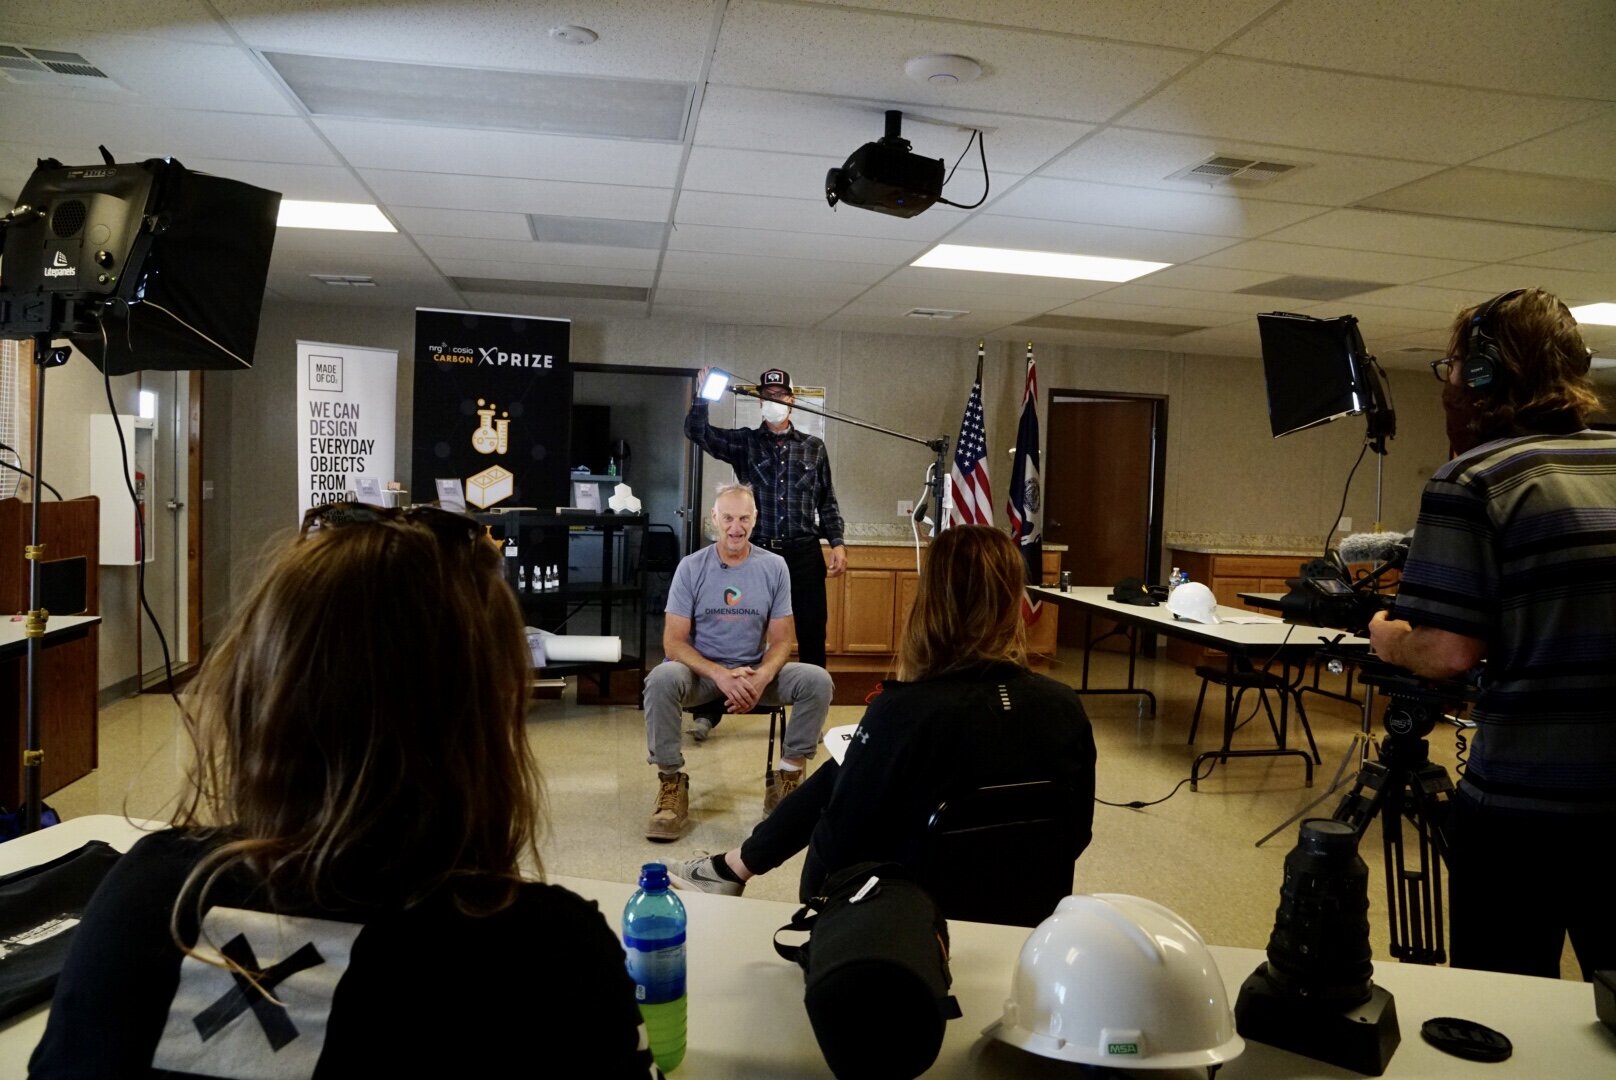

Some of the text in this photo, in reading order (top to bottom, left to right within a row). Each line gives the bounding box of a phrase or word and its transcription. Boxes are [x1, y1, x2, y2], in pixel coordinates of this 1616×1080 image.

[44, 267, 76, 277] Litepanels
[429, 345, 442, 353] nrg
[433, 346, 553, 368] CARBON XPRIZE
[316, 363, 336, 374] MADE
[316, 373, 325, 382] OF
[309, 401, 360, 419] WE CAN
[309, 420, 357, 437] DESIGN
[310, 438, 375, 455] EVERYDAY
[310, 456, 365, 473] OBJECTS
[310, 474, 346, 491] FROM
[1110, 1045, 1136, 1053] MSA
